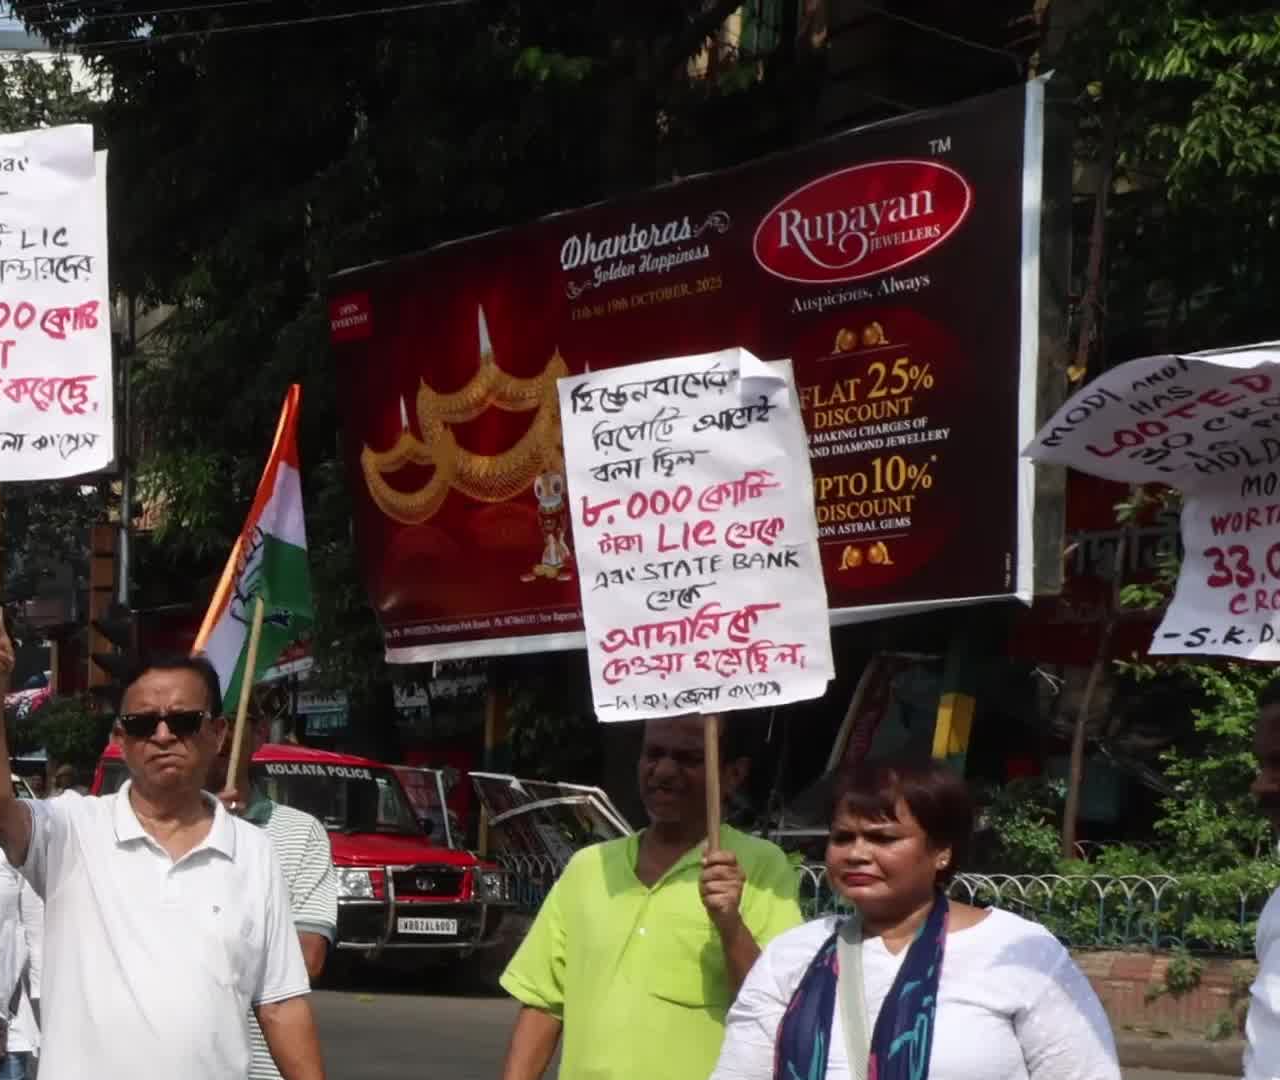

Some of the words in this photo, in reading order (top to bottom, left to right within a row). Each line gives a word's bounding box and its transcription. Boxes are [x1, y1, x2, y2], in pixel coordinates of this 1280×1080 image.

[21, 227, 69, 250] LIC
[560, 216, 692, 271] Dhanteras
[778, 189, 935, 269] Rupayan
[870, 223, 941, 253] JEWELLERS
[593, 260, 636, 287] Golden
[639, 244, 710, 274] Happiness
[878, 274, 931, 297] Always
[867, 357, 934, 400] 25%
[815, 397, 913, 428] DISCOUNT
[1128, 386, 1193, 415] HAS
[814, 429, 858, 445] MAKING
[858, 419, 911, 438] CHARGES
[912, 416, 928, 428] OF
[1042, 389, 1121, 446] MODI
[1085, 374, 1272, 458] LOOTED
[831, 437, 884, 456] DIAMOND
[886, 428, 950, 448] JEWELLERY
[815, 472, 868, 500] PTO
[1241, 471, 1280, 497] MO
[816, 495, 914, 523] DISCOUNT
[657, 520, 717, 552] LIC
[837, 521, 879, 535] ASTRAL
[880, 516, 911, 530] GEMS
[640, 554, 722, 581] STATE
[733, 549, 800, 569] BANK
[600, 602, 781, 653] আদানিকে
[265, 764, 324, 776] KOLKATA
[327, 765, 372, 781] POLICE
